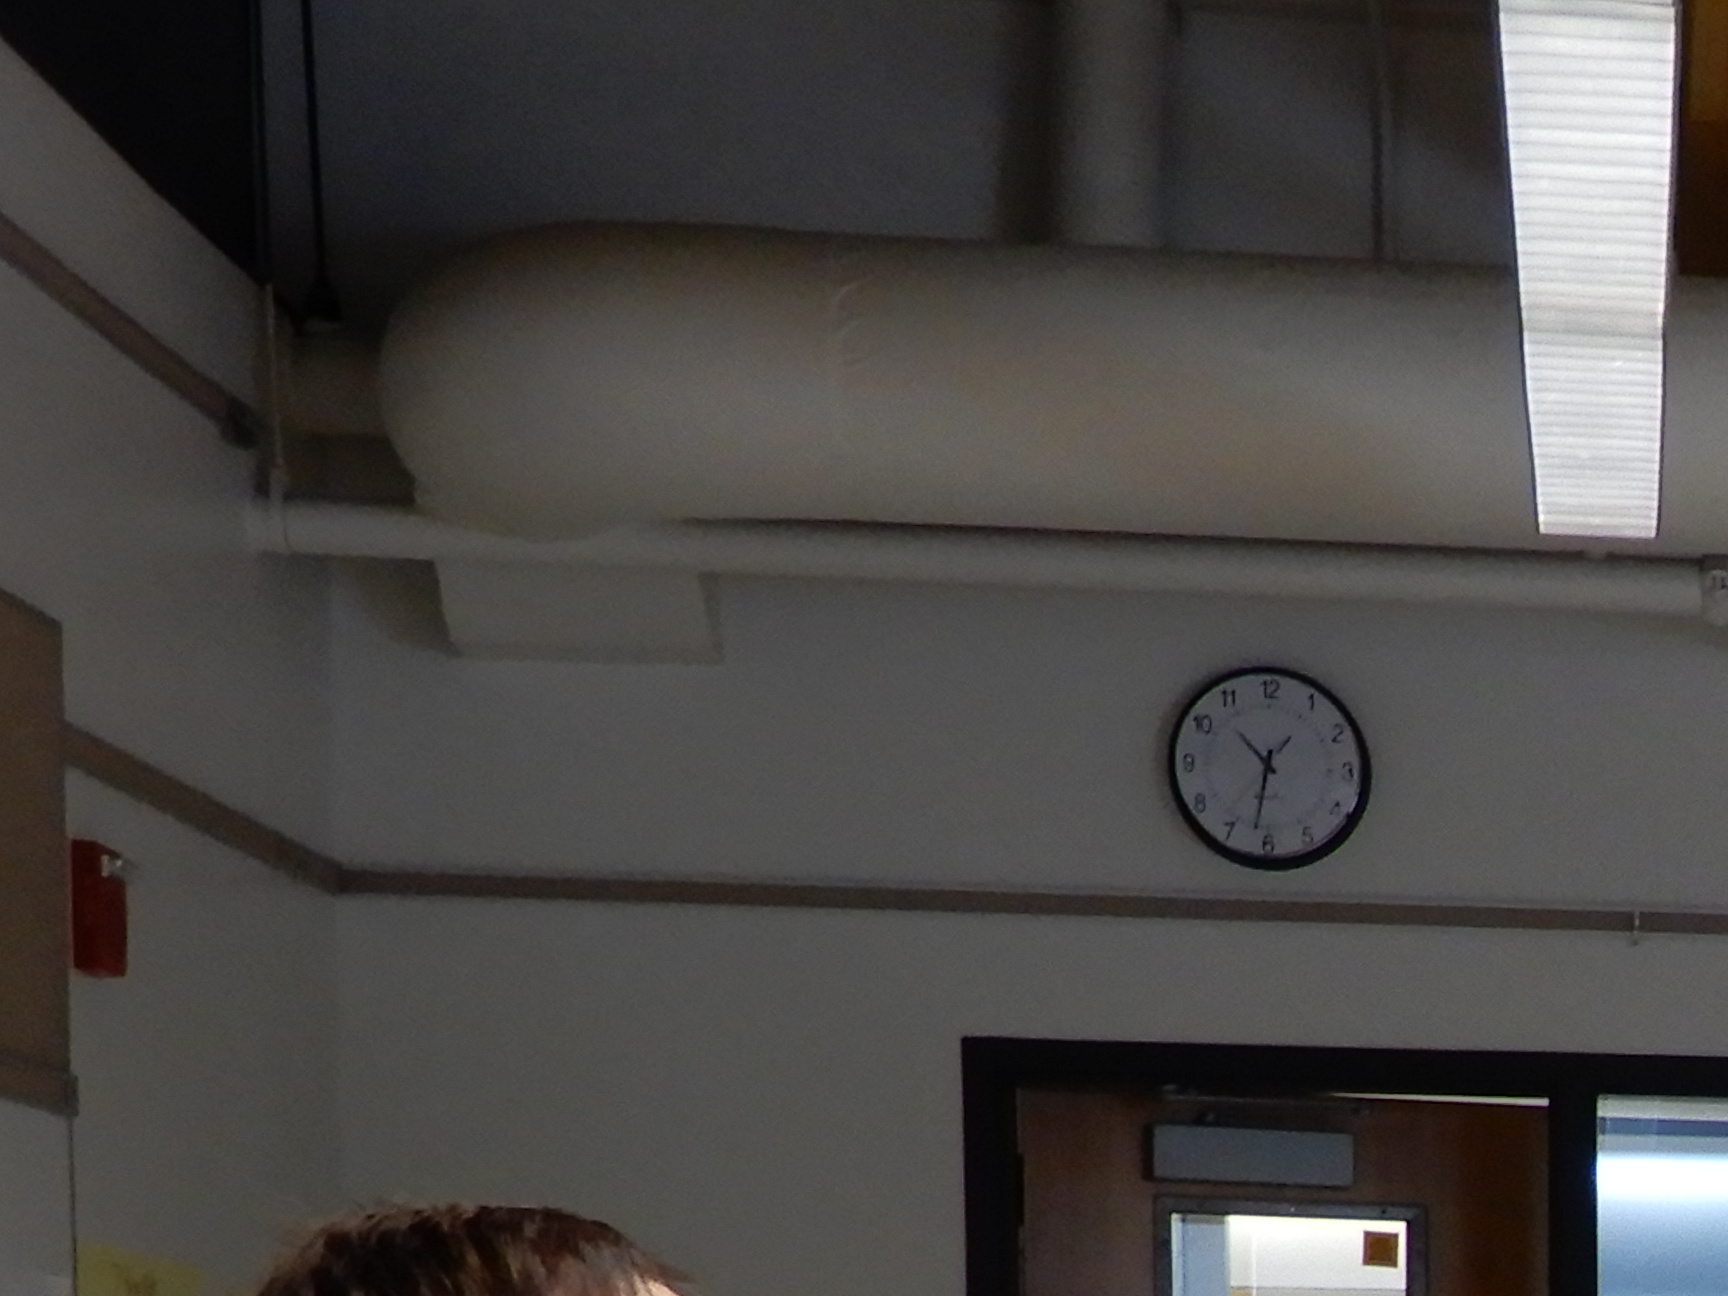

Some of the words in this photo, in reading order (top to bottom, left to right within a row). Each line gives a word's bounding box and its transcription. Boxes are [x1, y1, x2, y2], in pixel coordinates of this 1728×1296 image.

[1221, 689, 1236, 707] 11
[1260, 679, 1281, 699] 12
[1308, 693, 1315, 710] 1
[1193, 714, 1212, 735] 10
[1331, 724, 1344, 743] 2
[1183, 753, 1195, 773] 9
[1194, 793, 1207, 814] 8
[1224, 821, 1236, 840] 7
[1302, 826, 1314, 845] 5
[1262, 834, 1275, 853] 6
